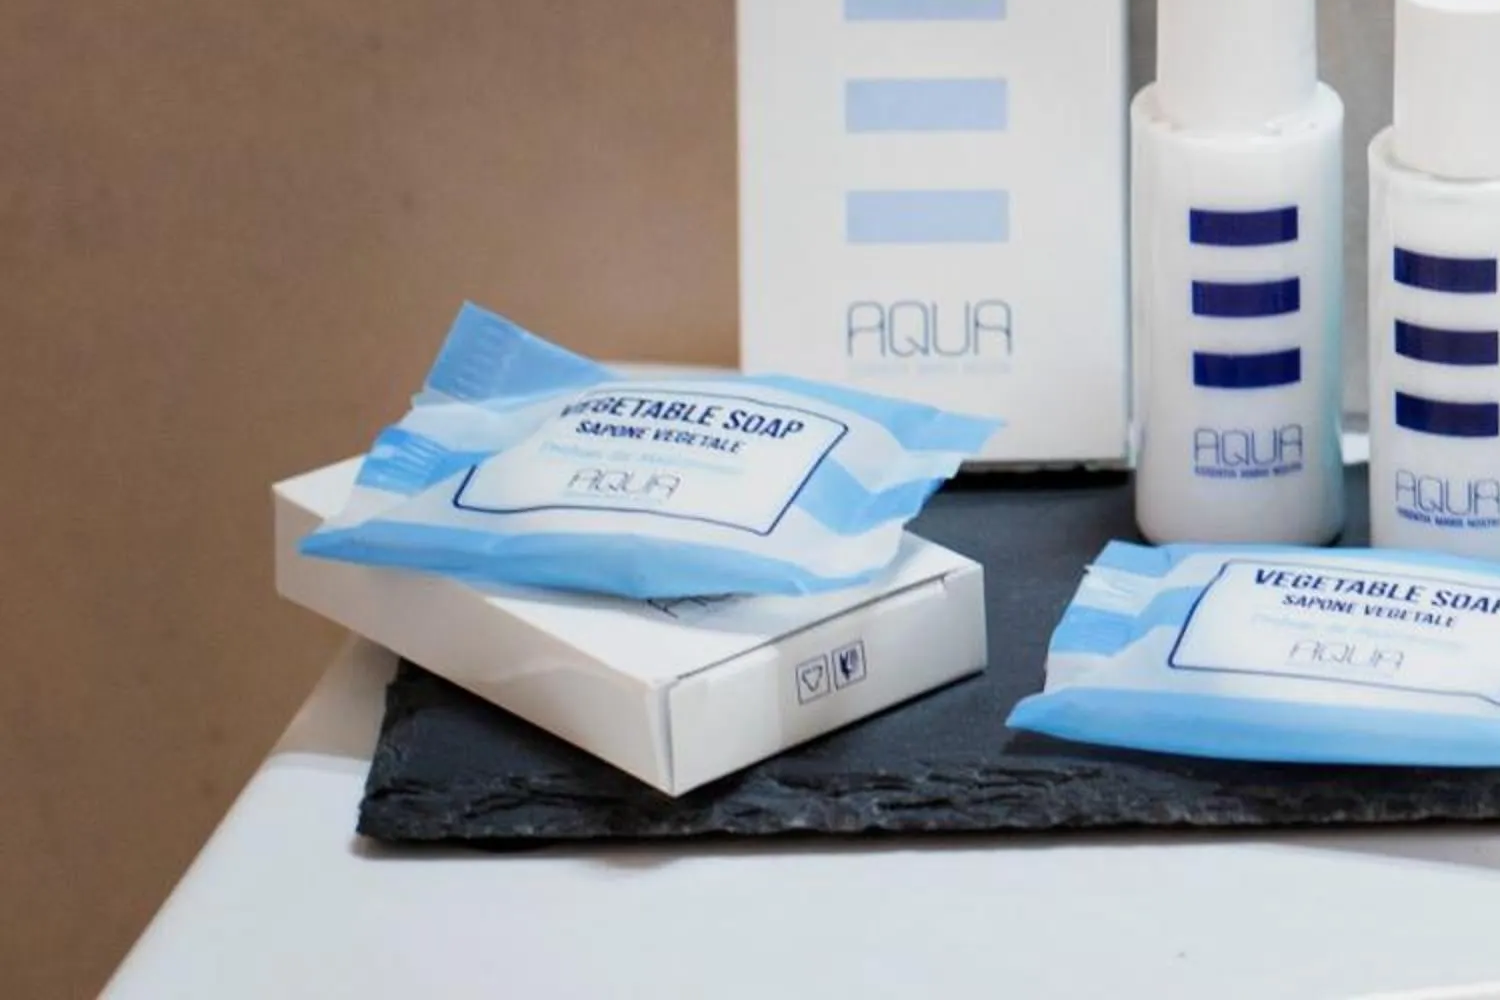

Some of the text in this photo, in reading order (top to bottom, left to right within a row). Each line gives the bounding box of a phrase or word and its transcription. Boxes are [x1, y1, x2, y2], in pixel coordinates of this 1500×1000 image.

[847, 299, 1012, 357] AQUA
[560, 397, 805, 439] VEGETABLE SOAP
[576, 420, 747, 453] SAPONE VEGETALE
[1194, 423, 1303, 466] AQUA
[567, 468, 681, 498] AQUA
[1395, 469, 1500, 516] AQUA
[1254, 569, 1426, 601] VEGETABLE
[1282, 594, 1456, 628] SAPONE VEGETALE
